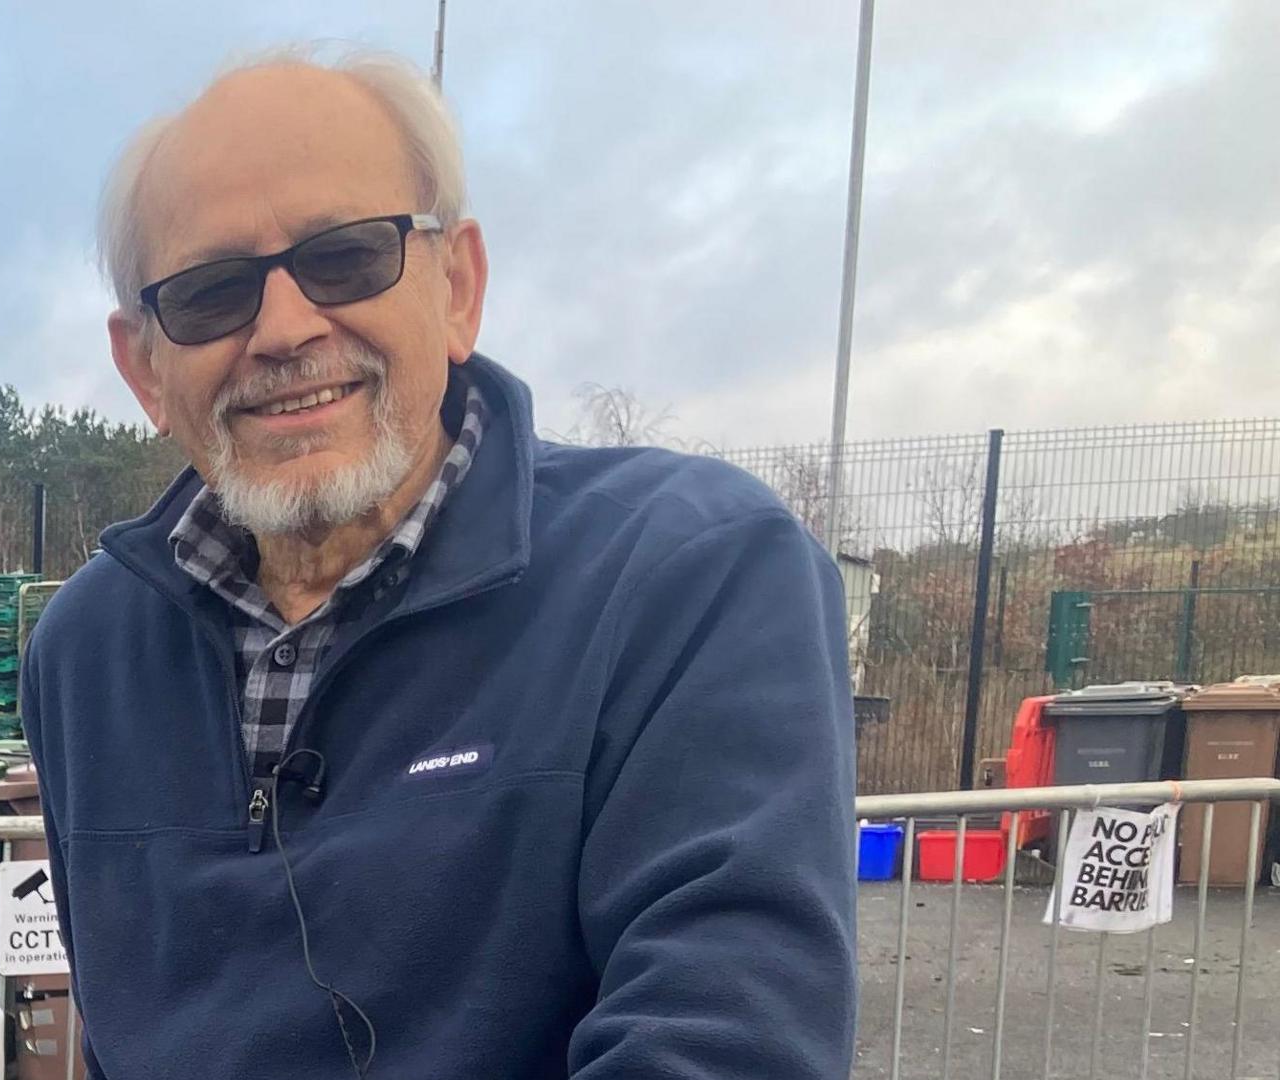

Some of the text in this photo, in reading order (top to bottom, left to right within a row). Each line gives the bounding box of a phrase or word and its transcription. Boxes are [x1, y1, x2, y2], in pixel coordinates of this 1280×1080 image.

[450, 751, 478, 766] END
[1092, 817, 1138, 843] NO
[1083, 841, 1150, 868] ACCE
[1077, 863, 1150, 890] BEHIN
[1070, 885, 1150, 912] BARRIE
[15, 912, 58, 923] Warnin
[5, 951, 68, 964] in operati
